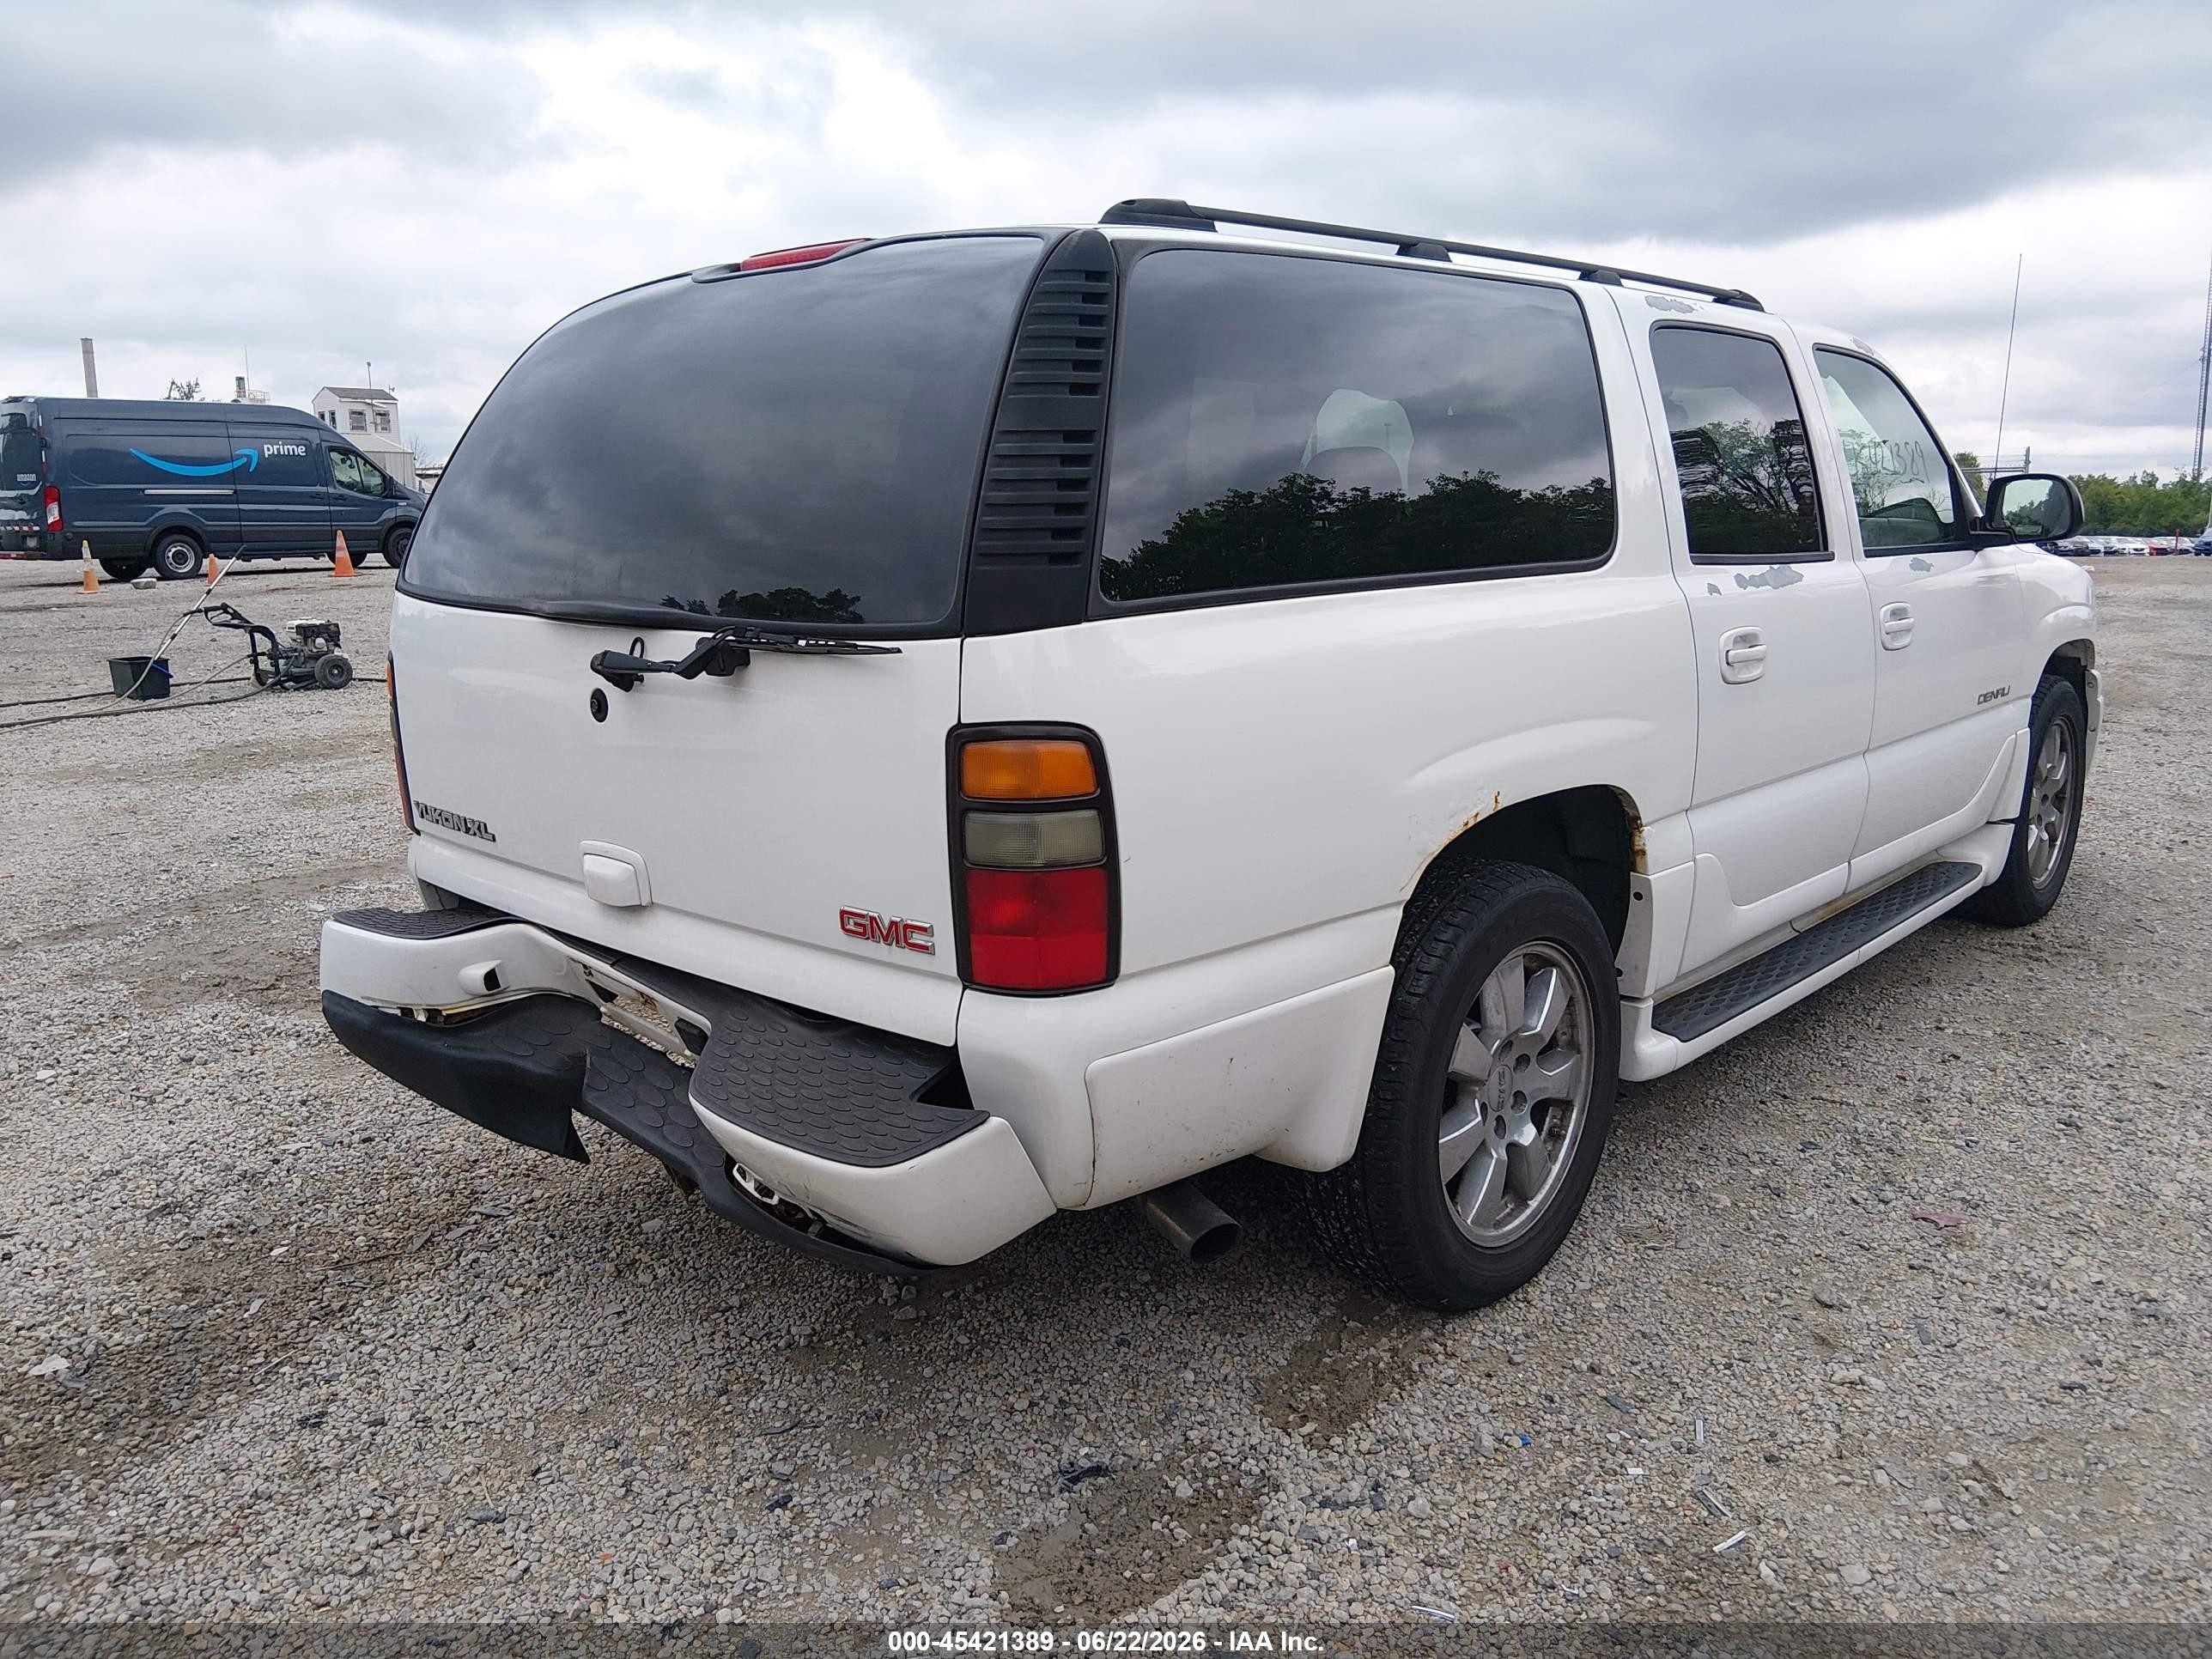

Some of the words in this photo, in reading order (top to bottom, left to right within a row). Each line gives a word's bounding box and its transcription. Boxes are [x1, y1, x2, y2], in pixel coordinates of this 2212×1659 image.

[264, 441, 306, 458] prime
[1978, 684, 2011, 706] DENALI
[413, 800, 467, 833] YUKON
[463, 817, 496, 842] XL
[838, 905, 936, 956] GMC
